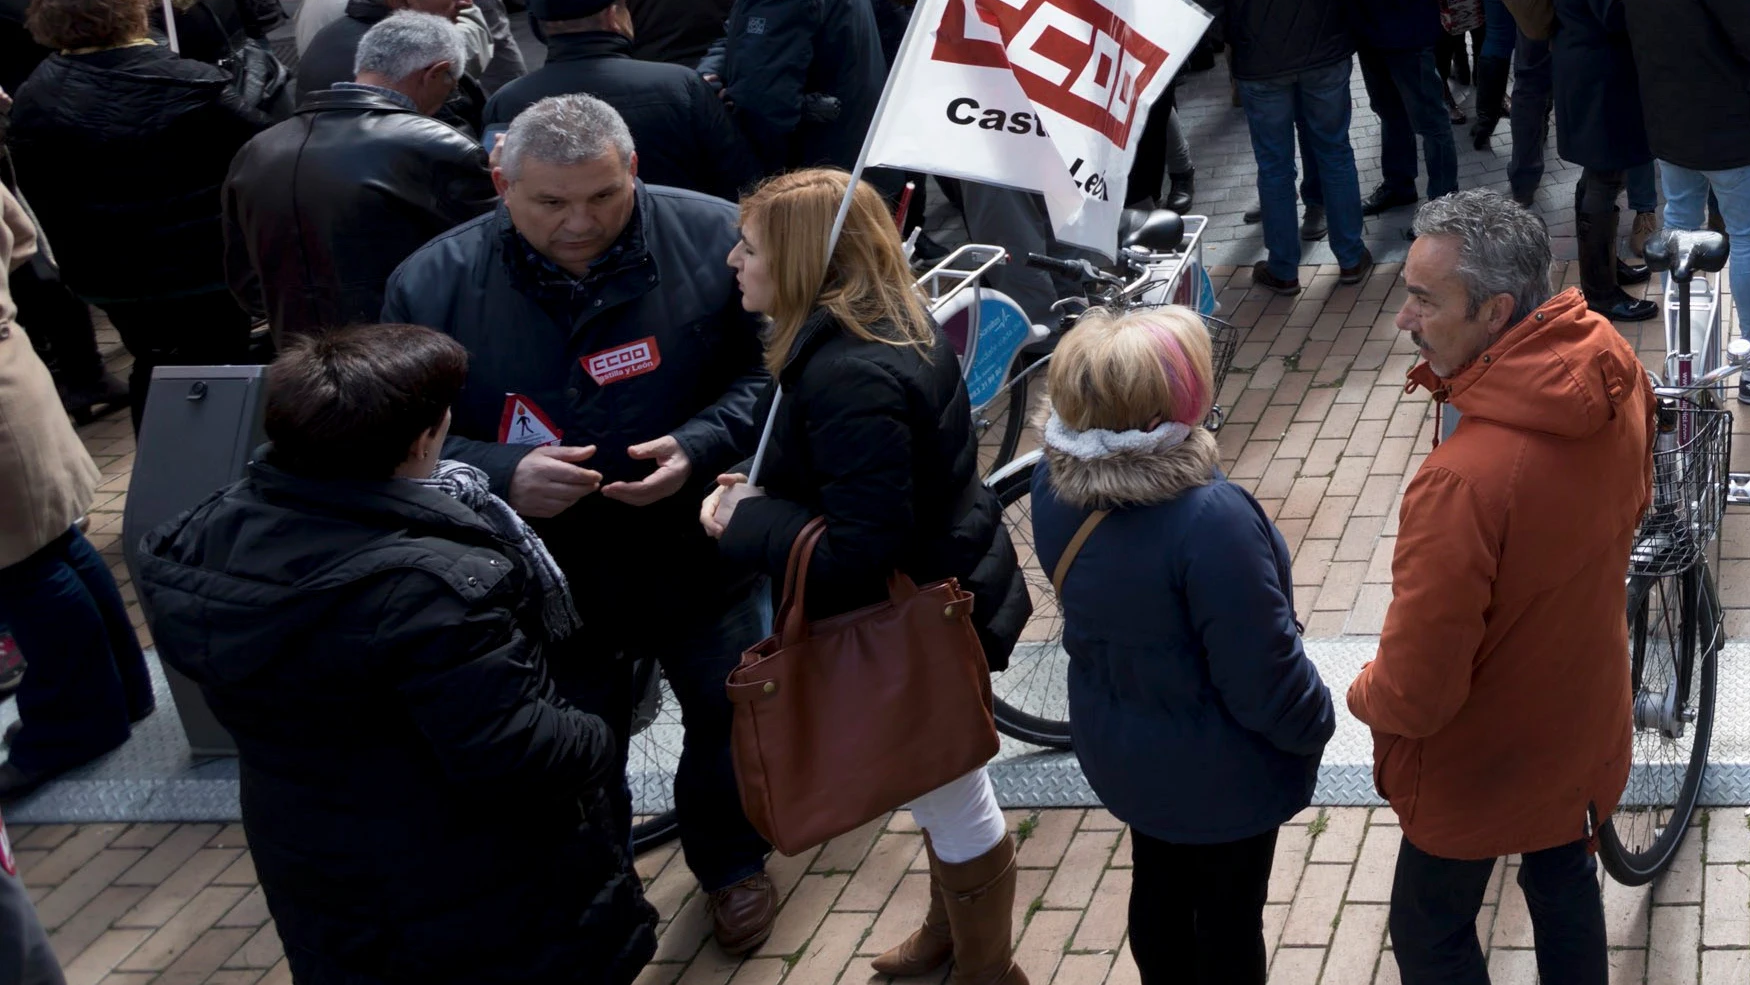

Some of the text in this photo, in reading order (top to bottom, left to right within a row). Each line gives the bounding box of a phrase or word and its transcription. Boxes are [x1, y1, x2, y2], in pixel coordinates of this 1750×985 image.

[946, 97, 1052, 139] Cast
[593, 347, 645, 371] CCOO
[599, 369, 624, 381] astilla
[632, 361, 653, 372] León
